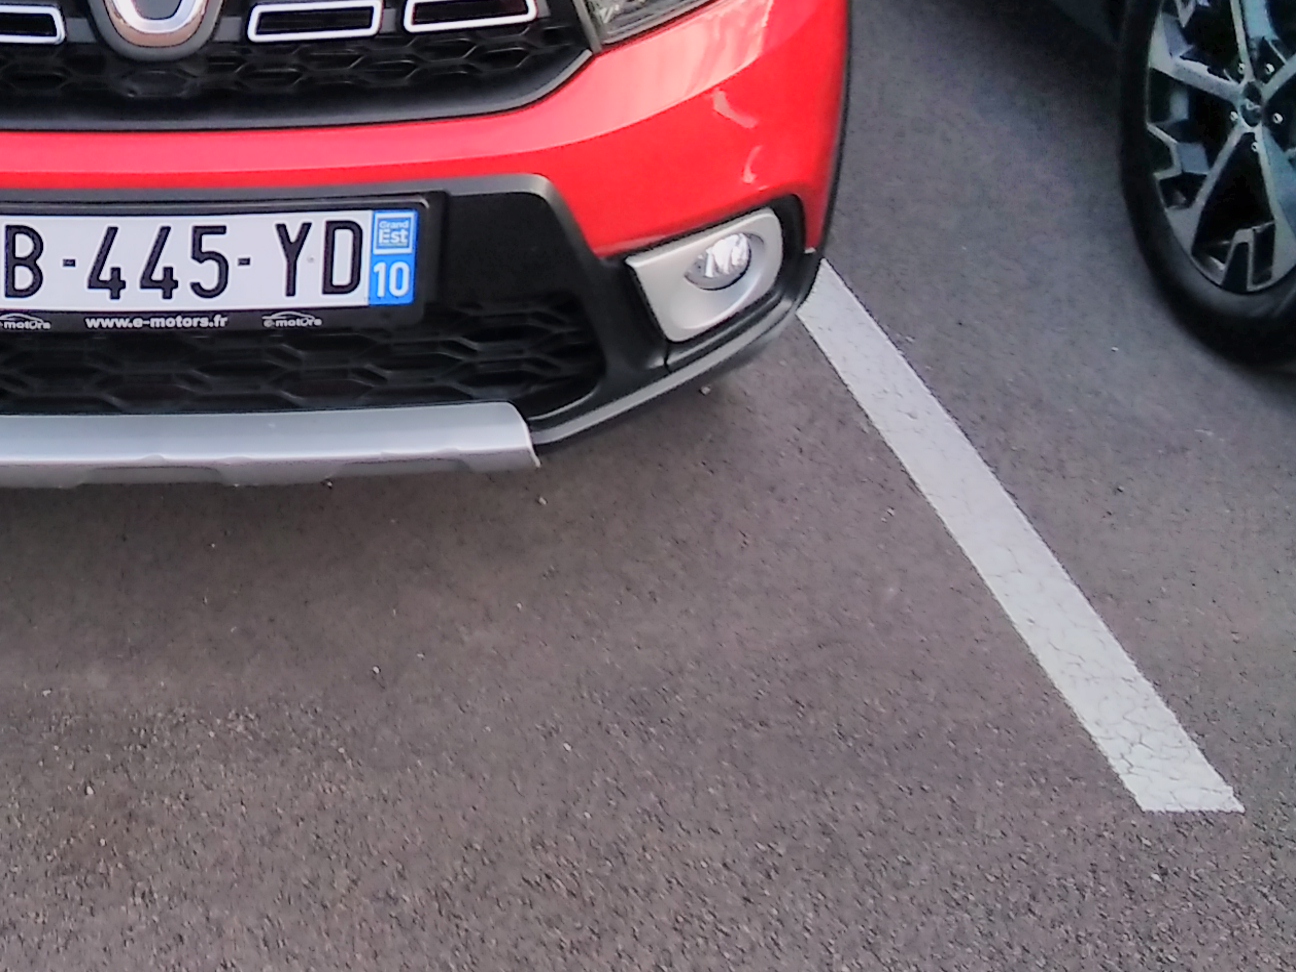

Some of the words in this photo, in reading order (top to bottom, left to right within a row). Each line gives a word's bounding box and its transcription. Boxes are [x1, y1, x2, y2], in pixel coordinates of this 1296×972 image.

[378, 219, 410, 229] Grand
[378, 229, 409, 244] Est
[373, 261, 410, 298] 10
[85, 313, 229, 329] www.e-motors.fr
